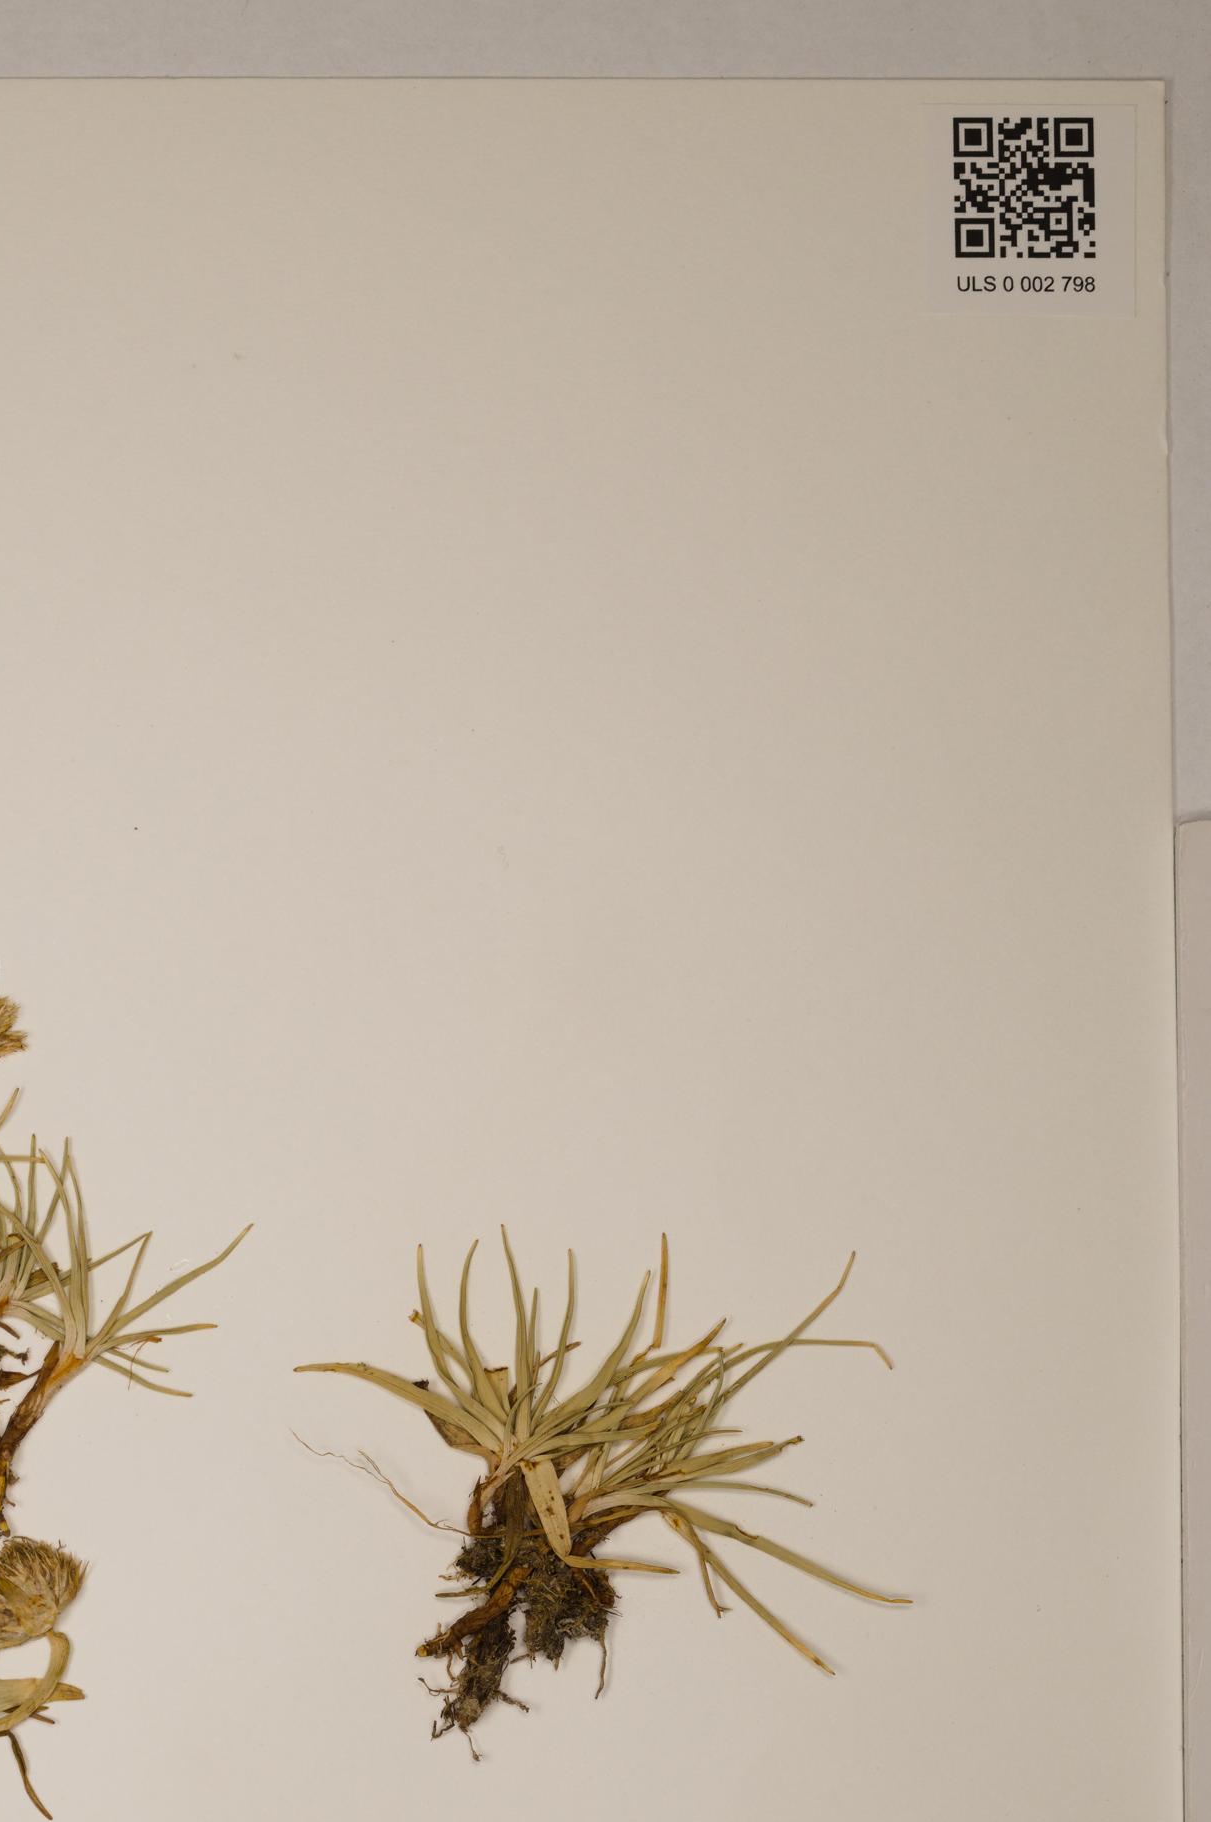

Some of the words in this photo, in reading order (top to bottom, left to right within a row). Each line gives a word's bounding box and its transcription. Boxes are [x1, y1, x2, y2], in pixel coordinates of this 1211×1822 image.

[957, 276, 996, 292] ULS
[1003, 276, 1014, 292] 0
[1021, 276, 1054, 292] 002
[1062, 276, 1096, 292] 798
